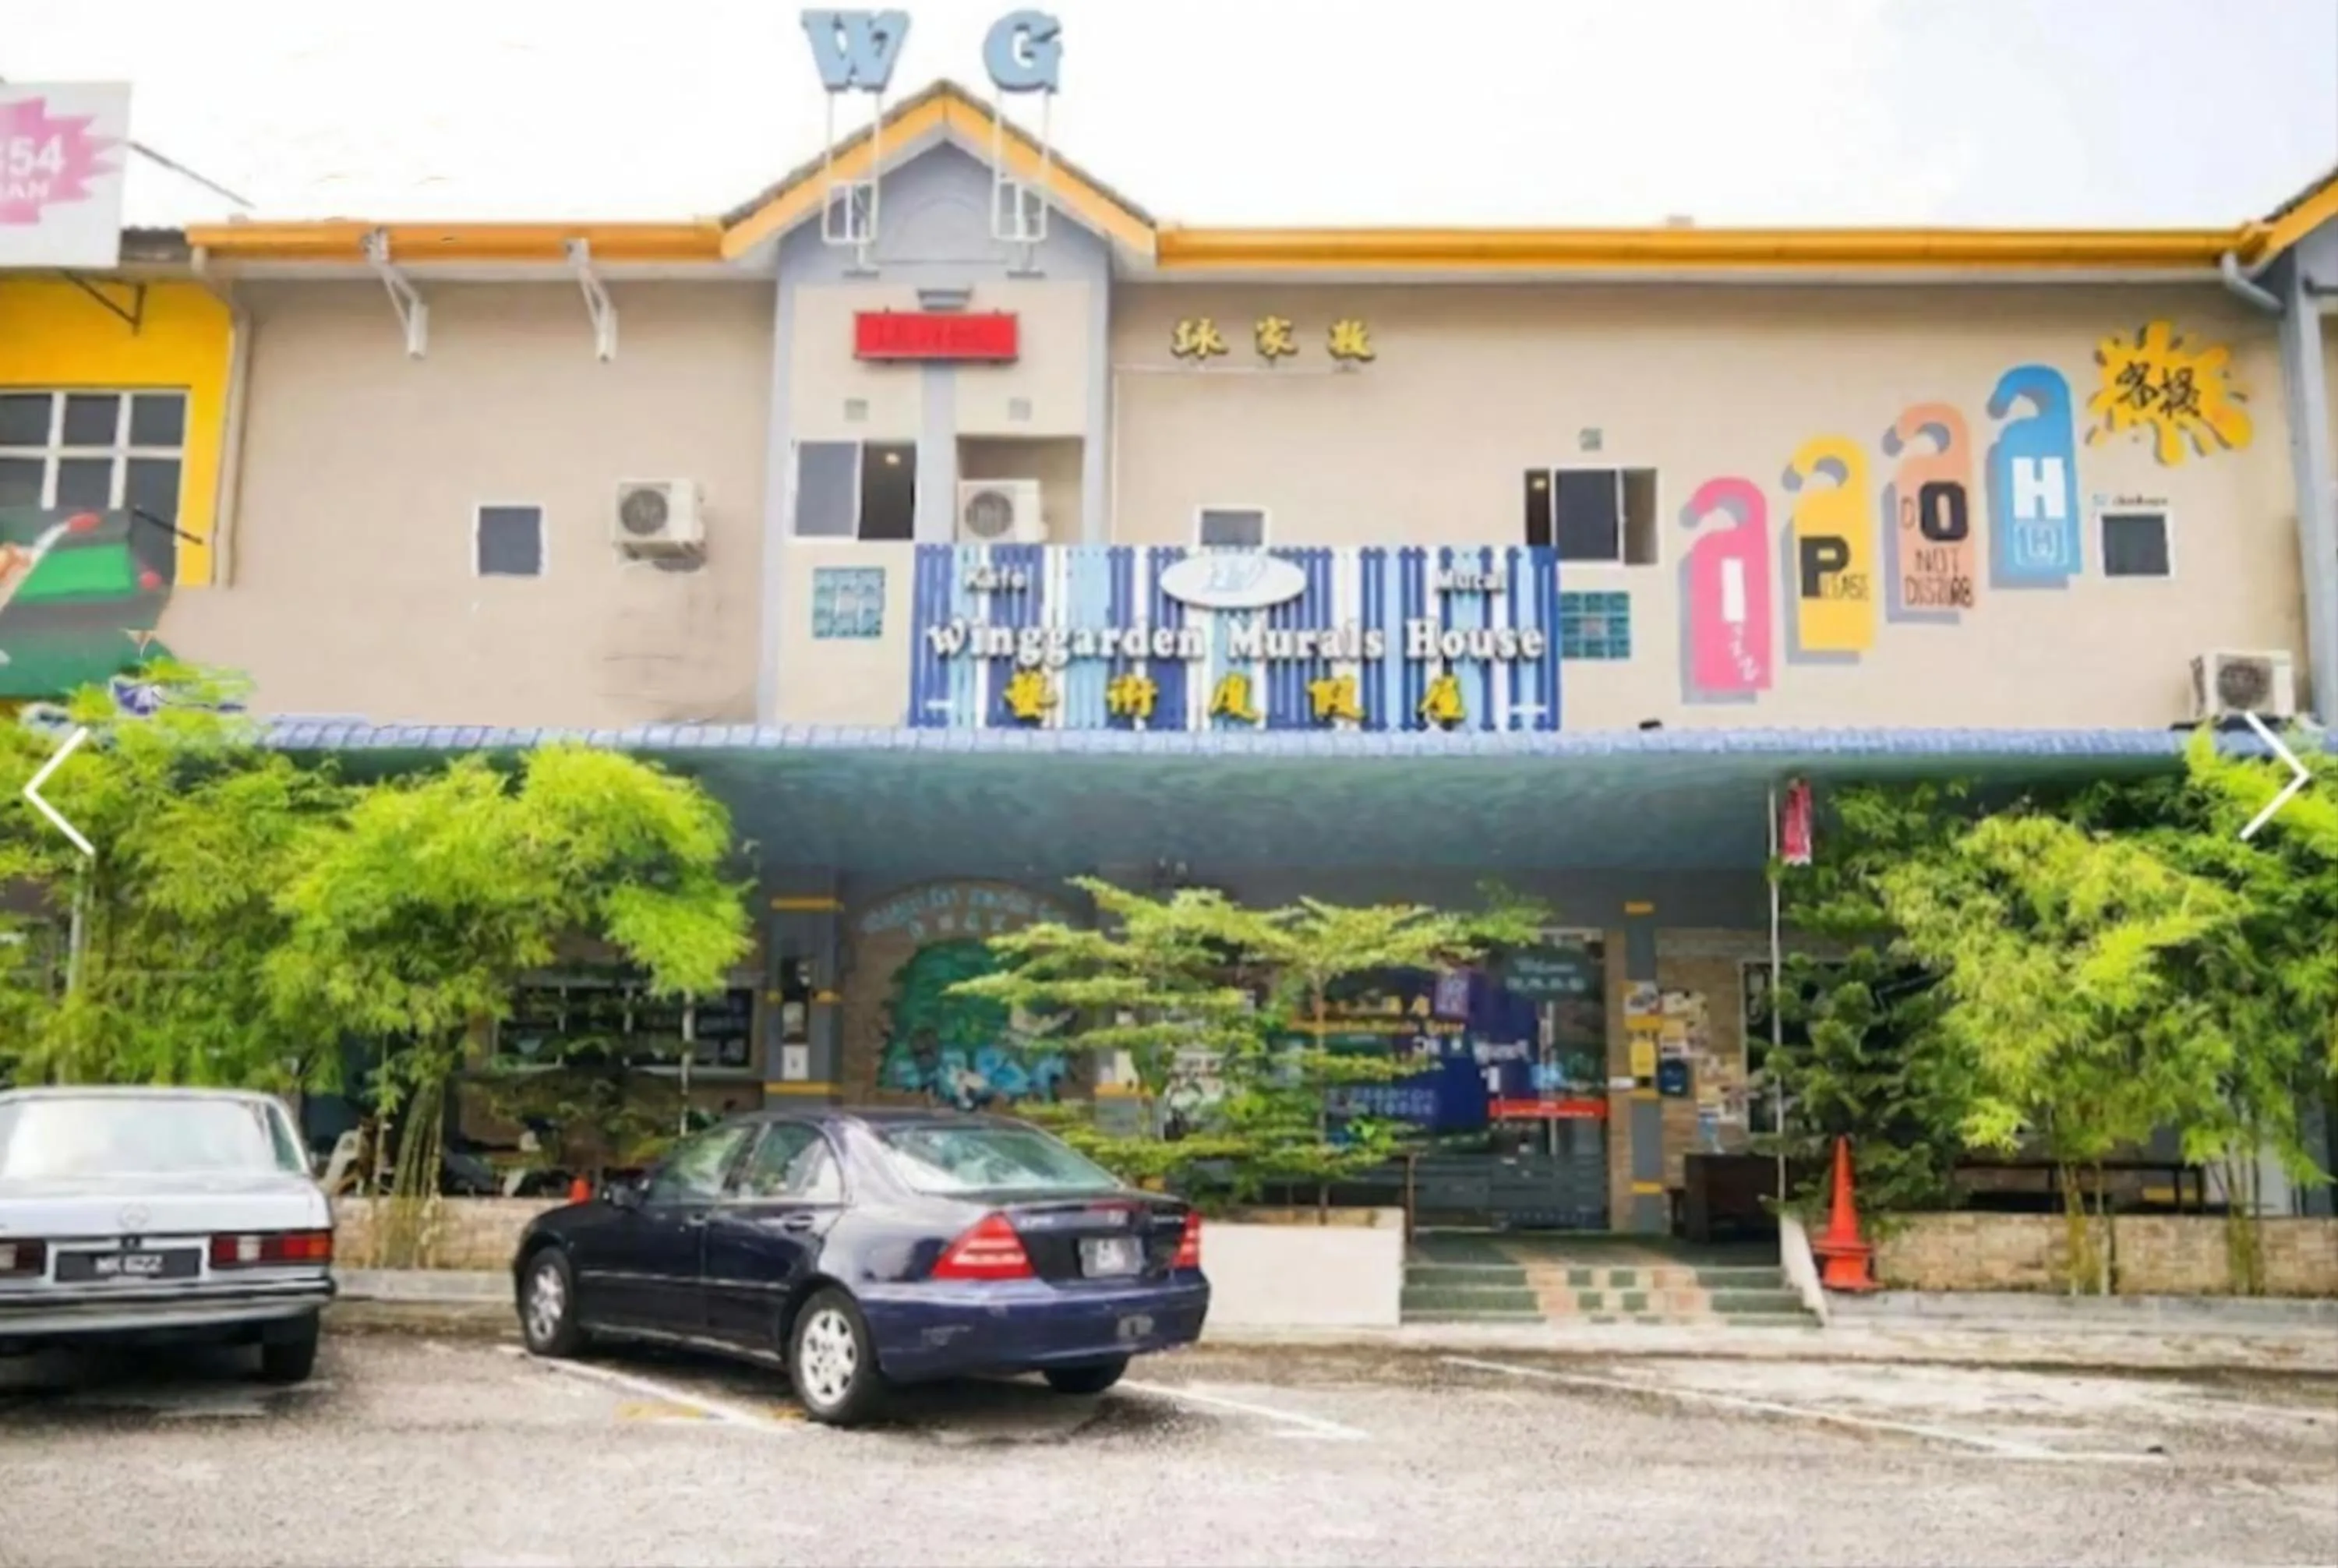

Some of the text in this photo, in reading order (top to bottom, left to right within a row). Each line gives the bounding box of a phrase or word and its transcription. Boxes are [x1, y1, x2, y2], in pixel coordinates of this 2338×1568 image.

[800, 9, 1065, 93] W G
[0, 134, 67, 177] 54
[1227, 616, 1386, 660] Murals
[1405, 618, 1545, 660] House
